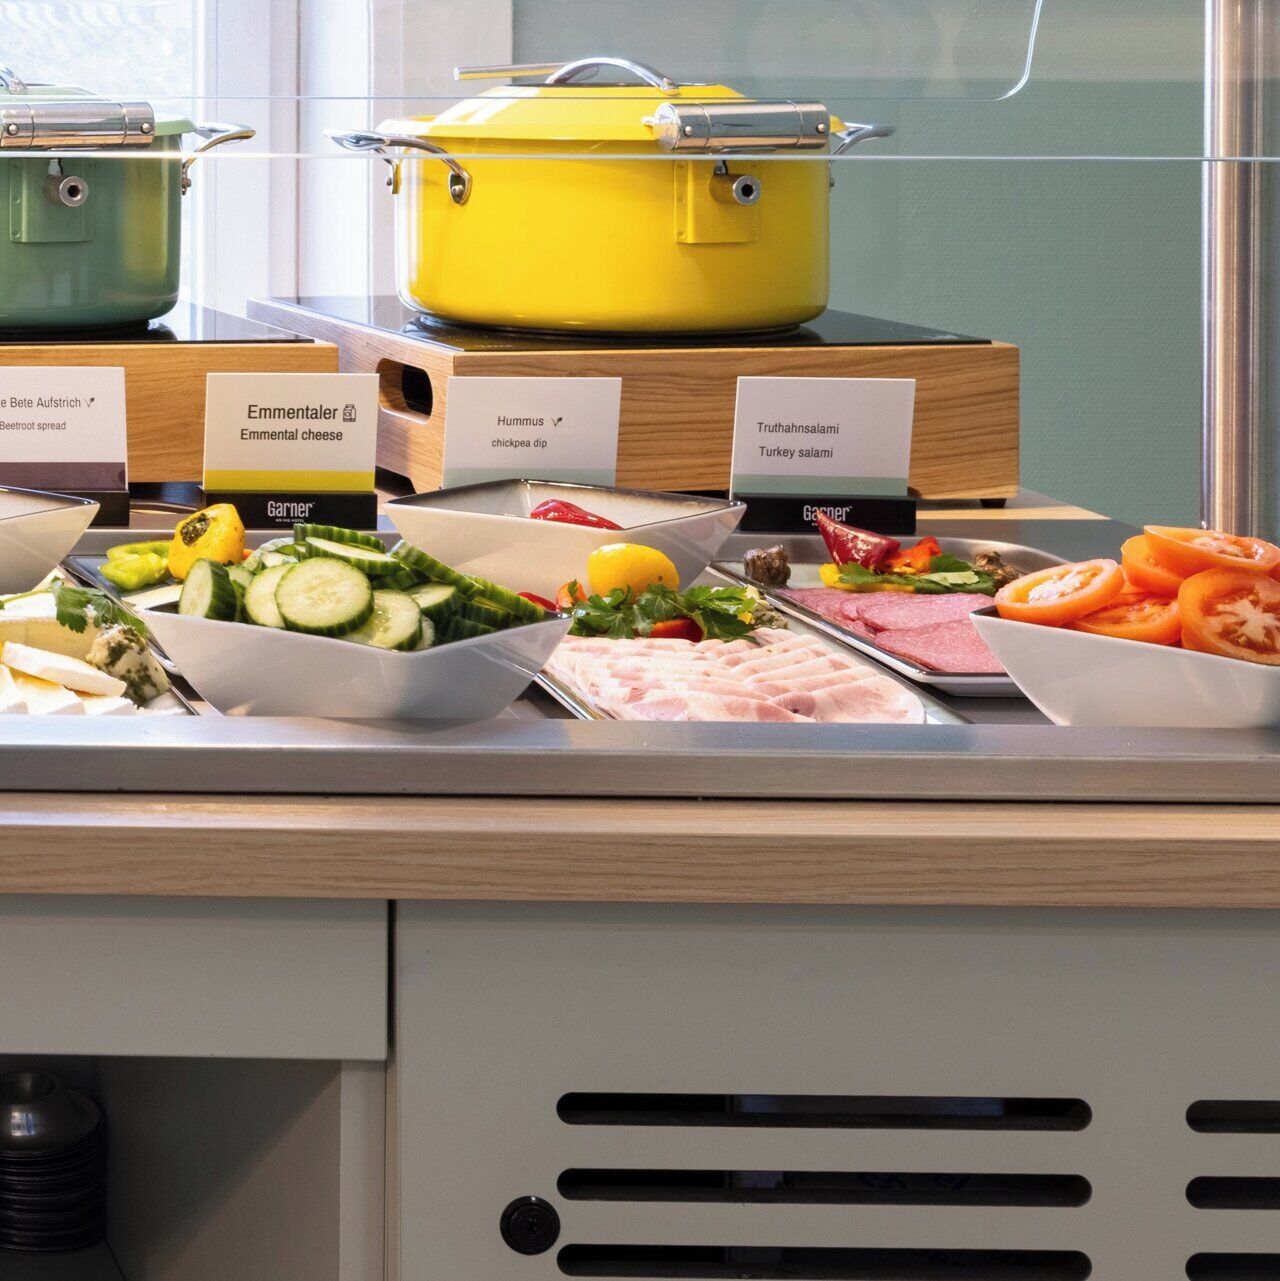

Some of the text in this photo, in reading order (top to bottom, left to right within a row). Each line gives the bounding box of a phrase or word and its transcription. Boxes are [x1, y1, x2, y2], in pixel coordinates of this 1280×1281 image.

[10, 397, 33, 408] Bete
[36, 396, 81, 408] Aufstrich
[248, 404, 338, 420] Emmentaler
[0, 420, 66, 432] Beetroot spread
[497, 416, 544, 426] Hummus
[757, 422, 840, 434] Truthahnsalami
[240, 428, 343, 441] Emmental cheese
[492, 438, 548, 449] chickpea dip
[759, 446, 834, 460] Turkey salami
[267, 500, 312, 518] Garner
